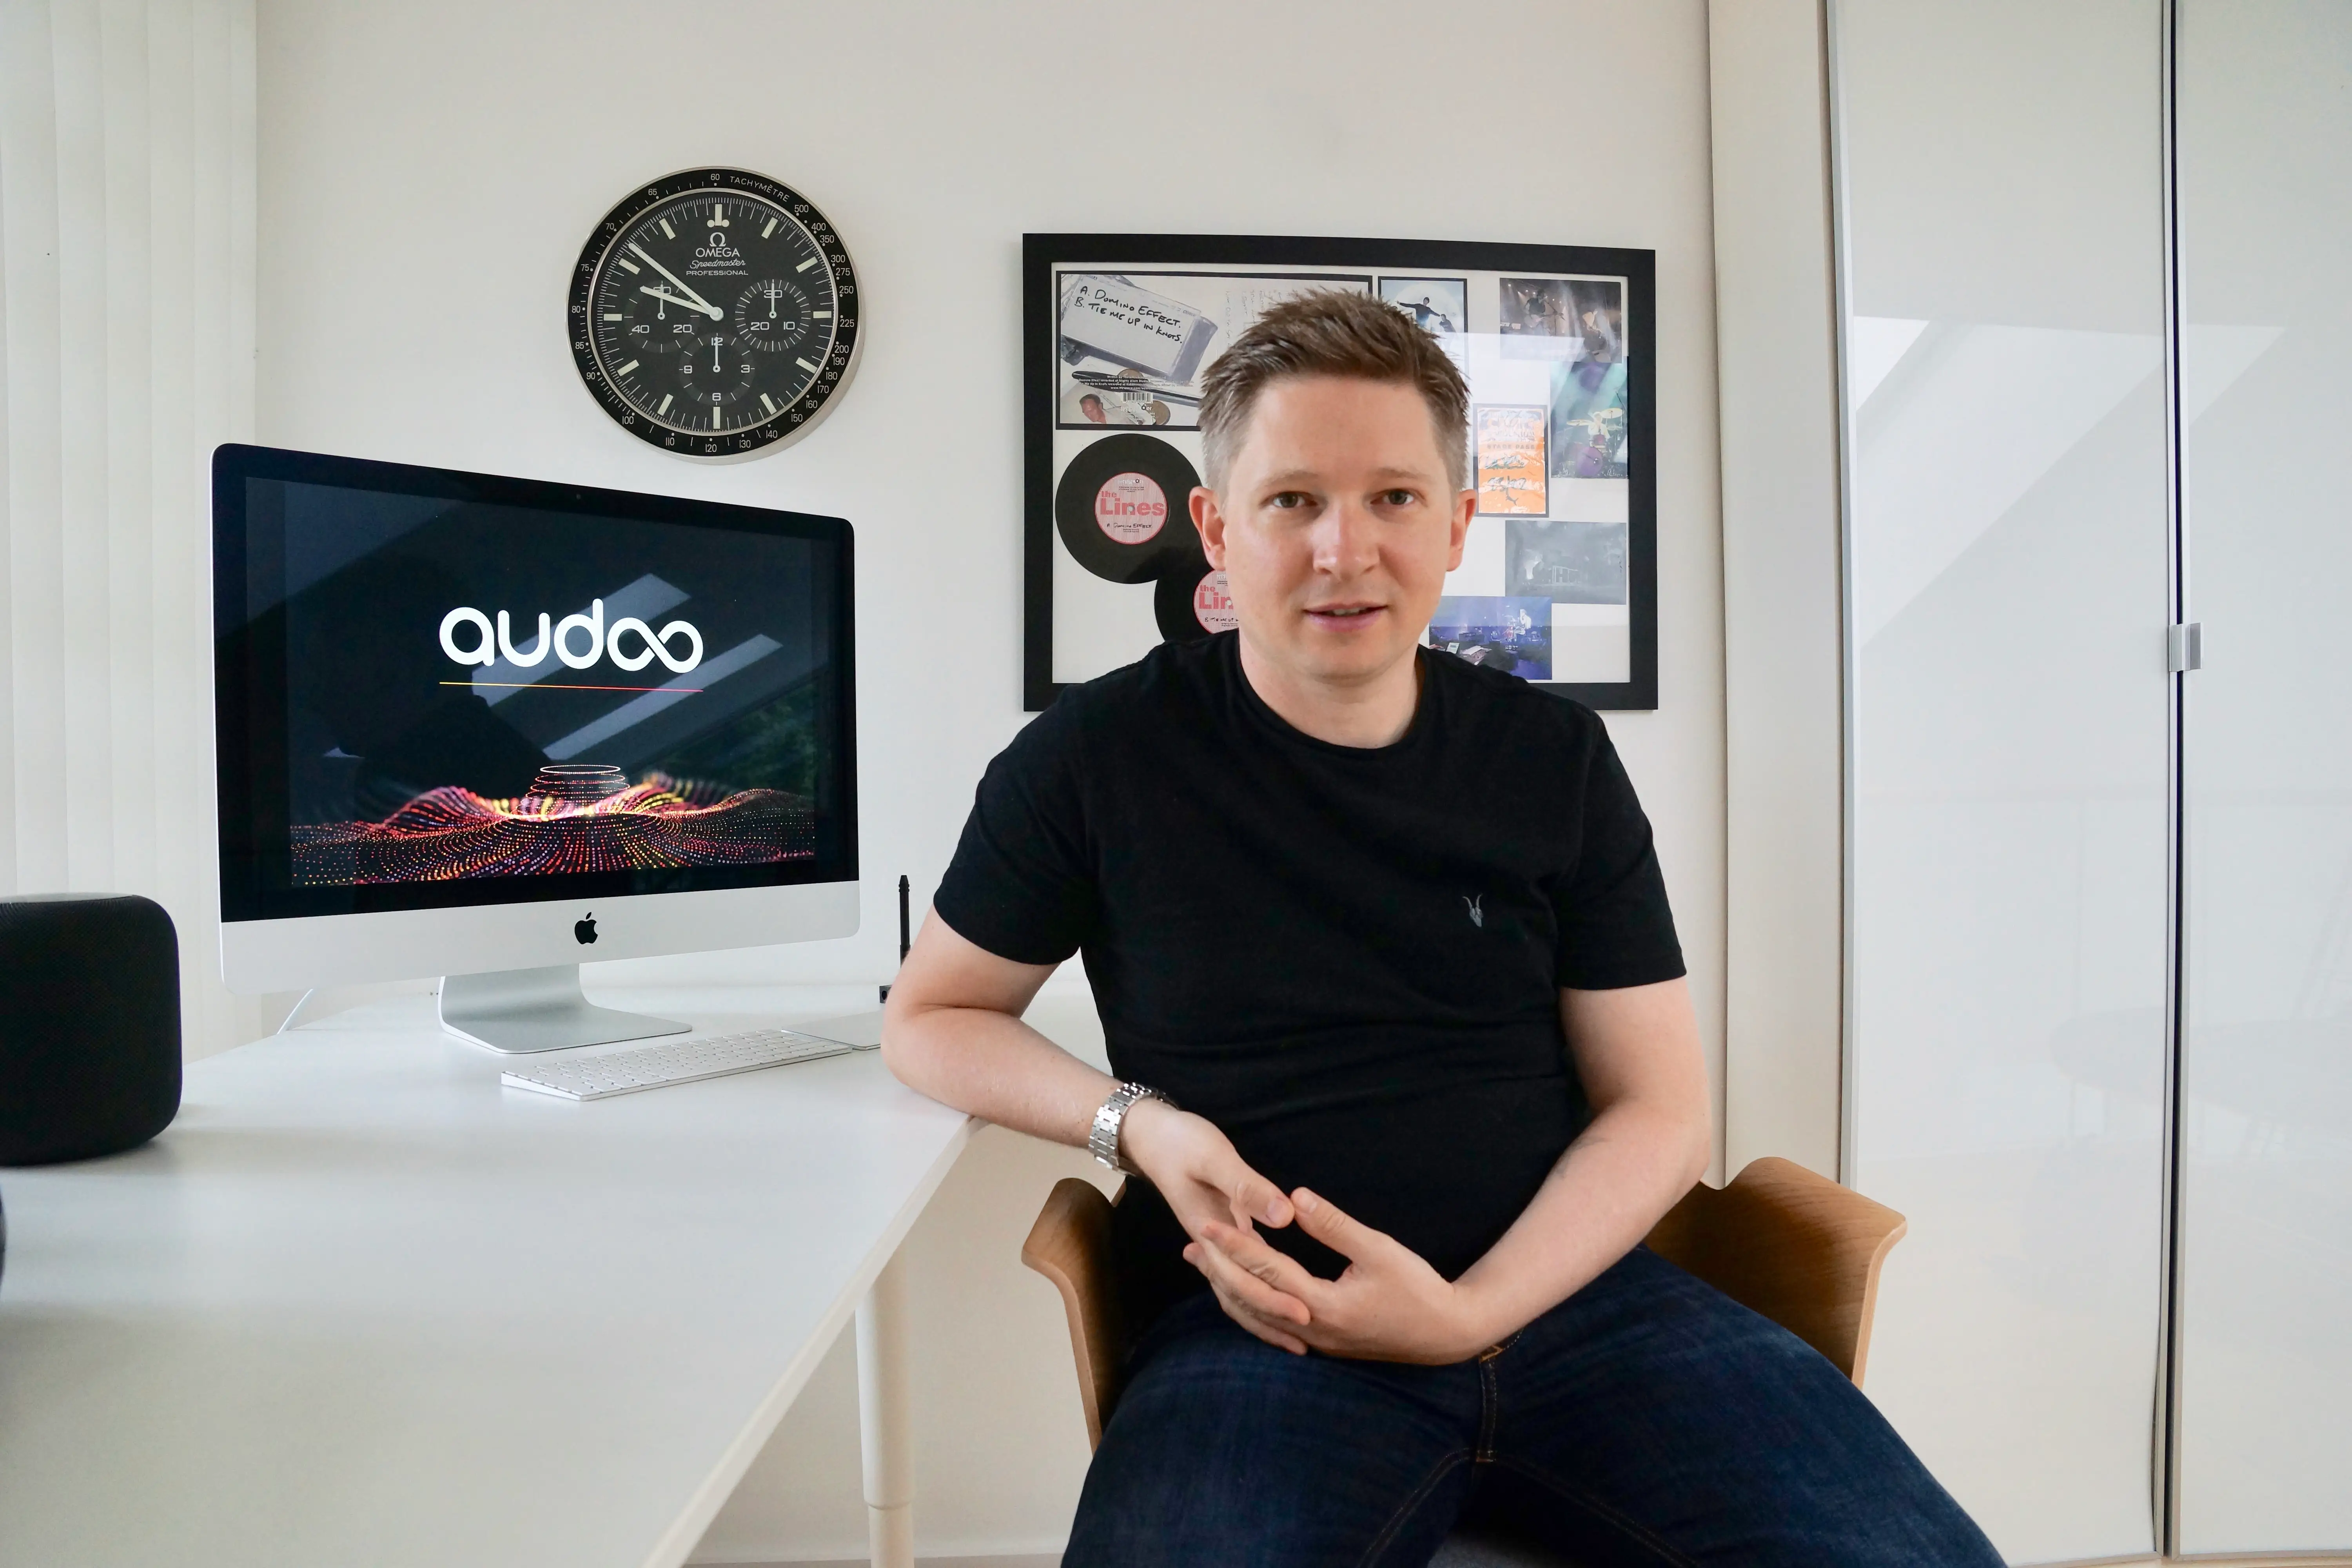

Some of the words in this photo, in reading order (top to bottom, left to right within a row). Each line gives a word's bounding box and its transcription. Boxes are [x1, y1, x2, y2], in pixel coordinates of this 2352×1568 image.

[730, 176, 790, 202] TACHYMÈTRE
[794, 205, 809, 213] 500
[811, 223, 826, 231] 400
[820, 235, 835, 243] 350
[695, 247, 740, 258] OMEGA
[831, 254, 846, 263] 300
[690, 259, 746, 269] Speedmaster
[835, 267, 850, 276] 275
[764, 290, 782, 298] 30
[839, 285, 854, 295] 250
[572, 305, 581, 314] 80
[1089, 303, 1107, 314] TIE
[1110, 312, 1126, 320] ME
[1127, 318, 1141, 326] UP
[1138, 306, 1181, 328] EFFECT.
[750, 322, 769, 330] 20
[783, 321, 795, 330] 10
[840, 319, 855, 327] 225
[632, 325, 649, 333] 40
[673, 324, 692, 333] 20
[711, 337, 723, 346] 12
[834, 345, 849, 354] 200
[833, 357, 845, 366] 190
[684, 365, 692, 374] 9
[741, 365, 750, 373] 3
[586, 372, 595, 380] 90
[826, 371, 838, 380] 180
[817, 385, 829, 394] 170
[712, 392, 721, 401] 6
[806, 400, 818, 408] 160
[622, 416, 634, 425] 100
[791, 414, 803, 422] 150
[766, 430, 778, 439] 140
[666, 437, 675, 446] 110
[739, 439, 751, 448] 130
[705, 444, 717, 453] 120
[1100, 497, 1165, 516] Lines
[1199, 592, 1234, 610] Lin
